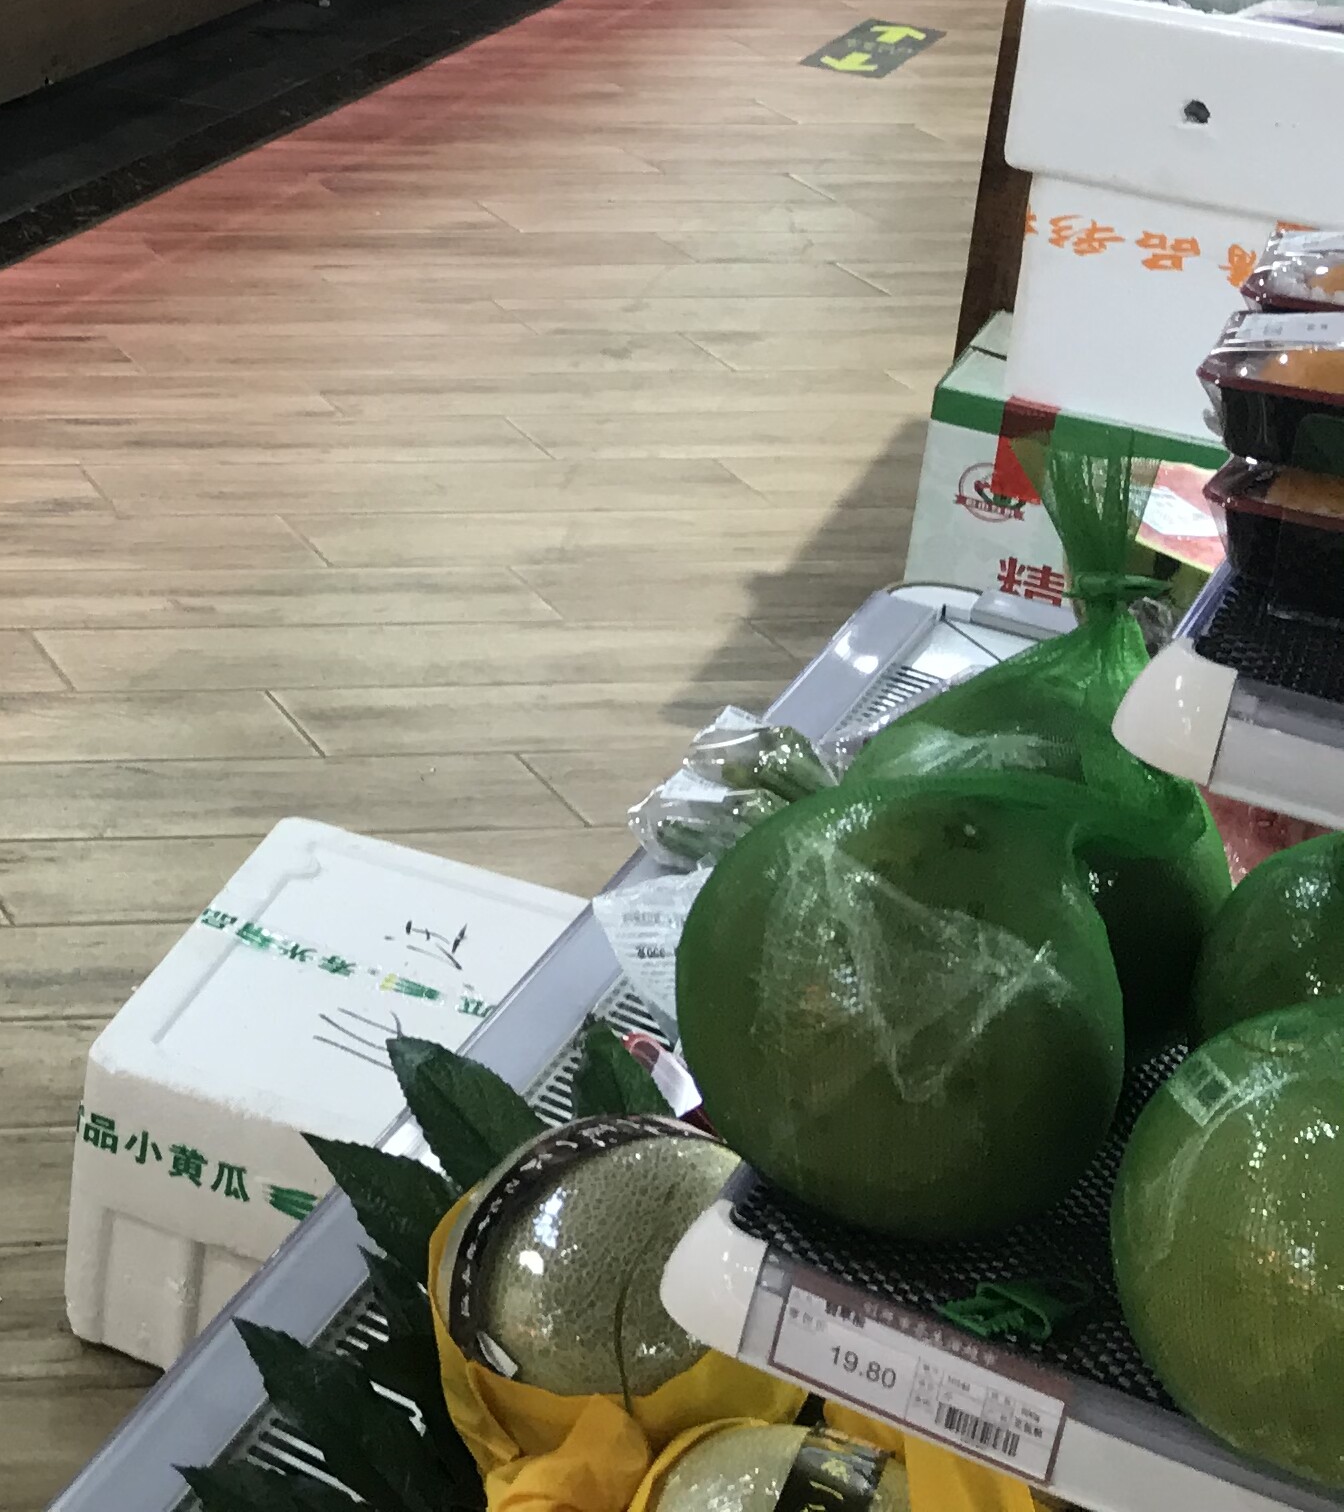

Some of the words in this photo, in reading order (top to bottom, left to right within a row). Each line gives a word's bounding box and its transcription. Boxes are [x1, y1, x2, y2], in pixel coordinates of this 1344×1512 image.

[997, 557, 1064, 607] 精
[77, 1104, 250, 1202] 品小黄瓜
[831, 1345, 897, 1389] 19.80
